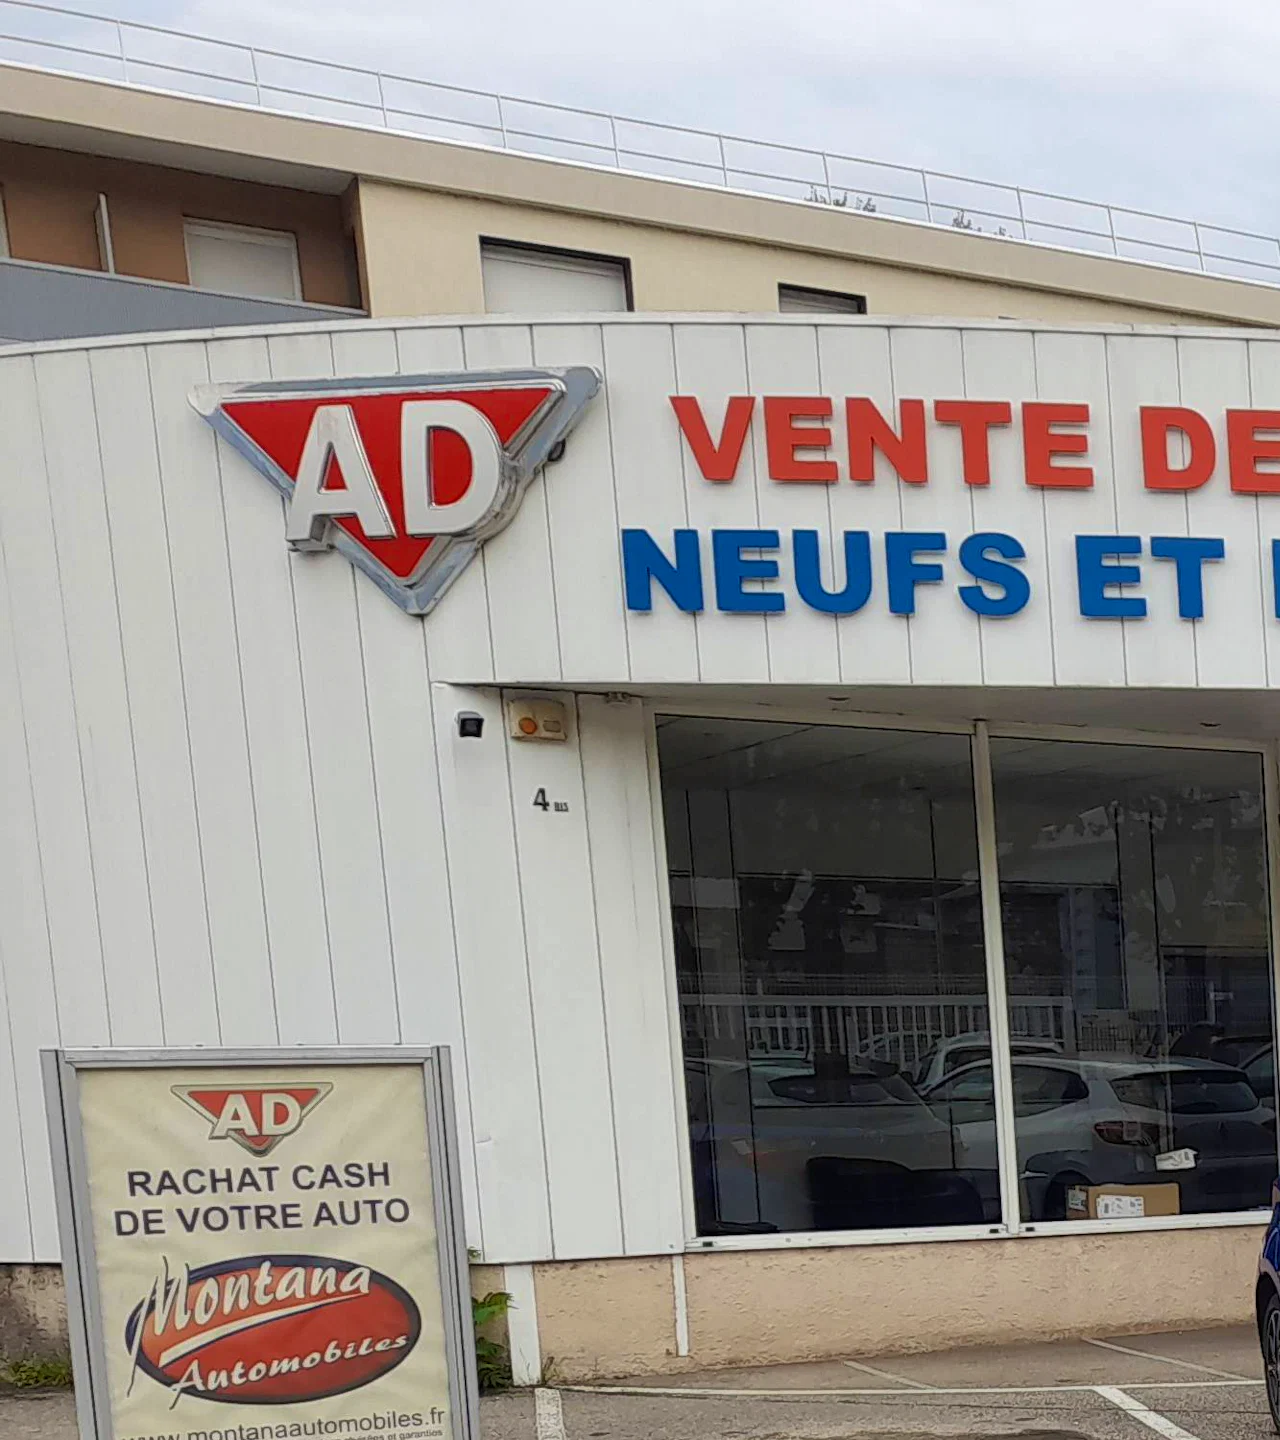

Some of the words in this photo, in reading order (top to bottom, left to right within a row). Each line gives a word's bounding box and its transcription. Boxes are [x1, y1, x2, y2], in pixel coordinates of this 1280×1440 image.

[286, 399, 513, 542] AD
[669, 394, 1095, 489] VENTE
[621, 527, 1032, 619] NEUFS
[1074, 535, 1226, 620] ET
[532, 787, 550, 812] 4
[213, 1092, 301, 1137] AD
[114, 1209, 166, 1236] DE
[176, 1203, 302, 1233] VOTRE
[313, 1198, 410, 1228] AUTO
[127, 1166, 280, 1197] RACHAT
[292, 1162, 390, 1190] CASH
[127, 1255, 371, 1398] Montana
[168, 1332, 410, 1411] Automobiles
